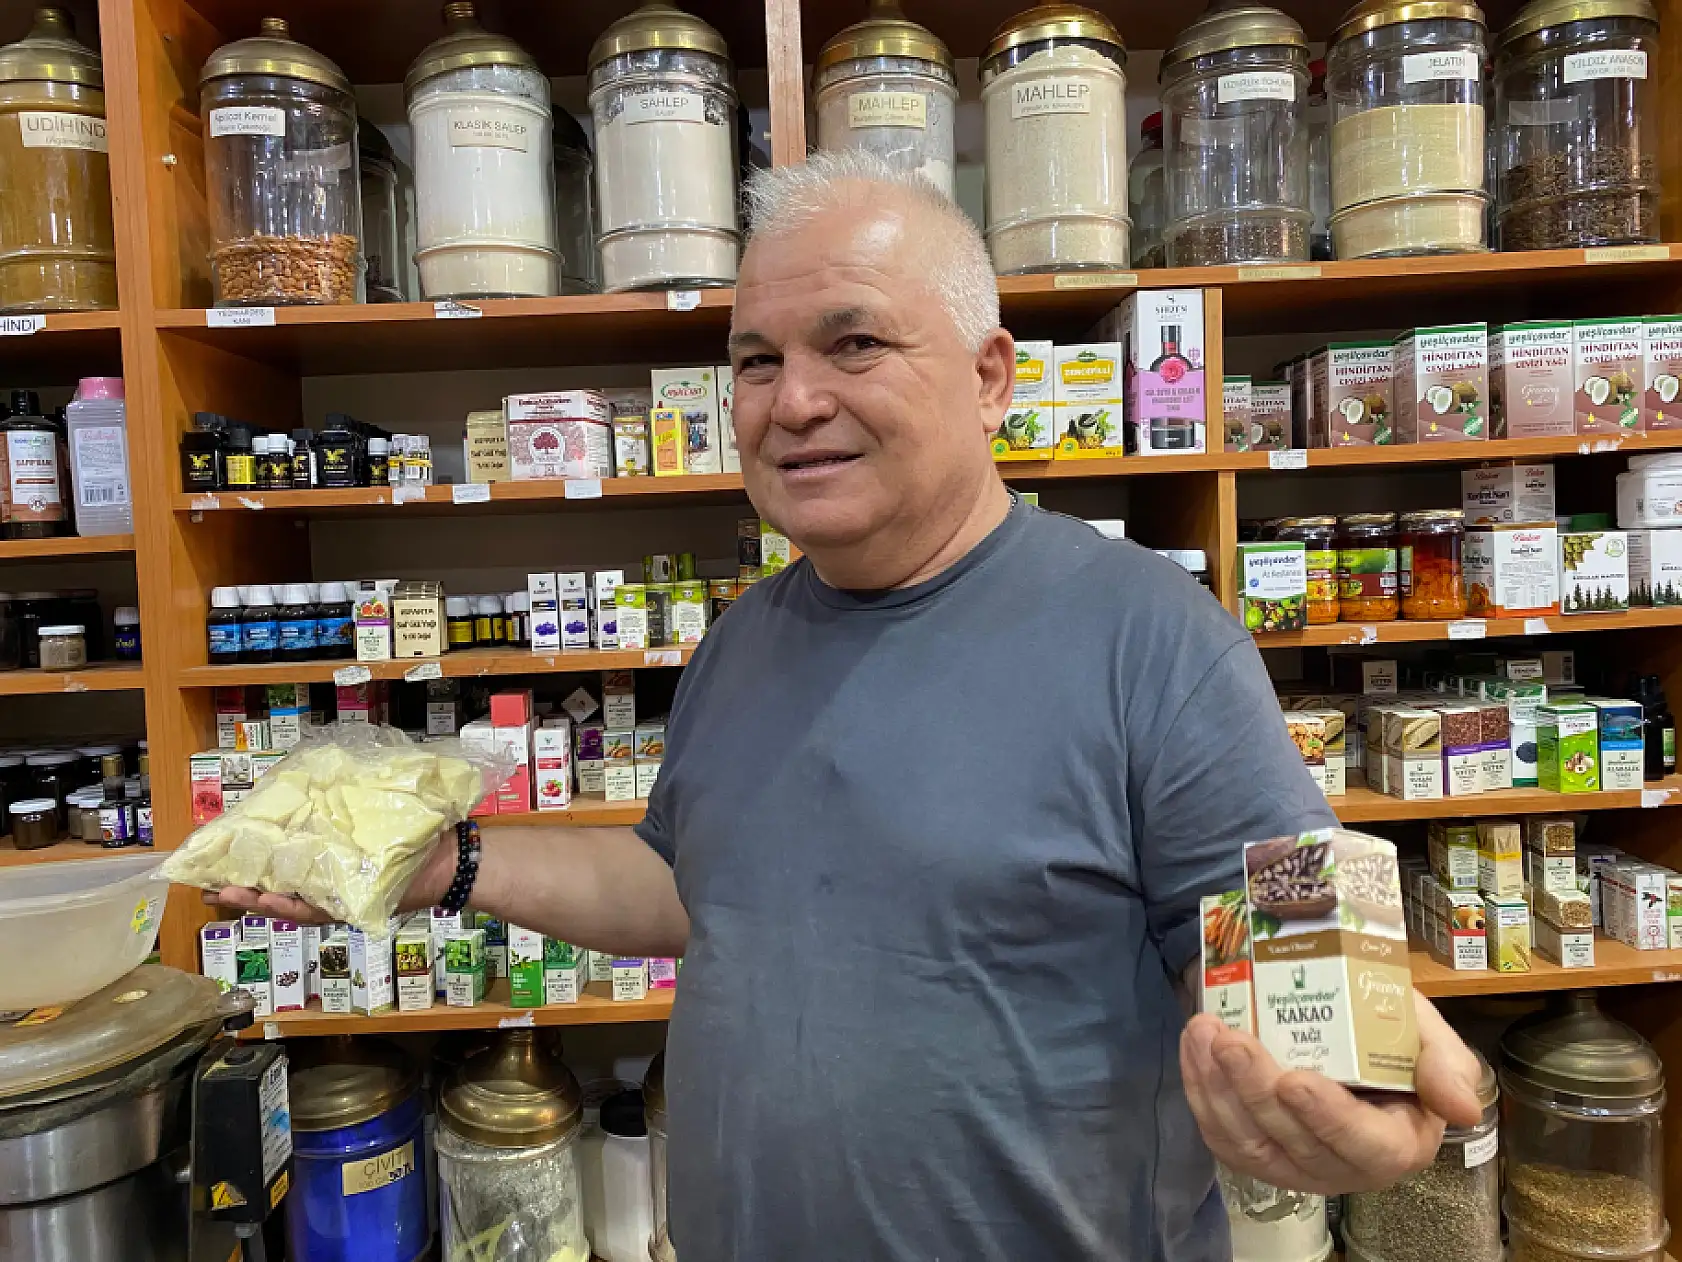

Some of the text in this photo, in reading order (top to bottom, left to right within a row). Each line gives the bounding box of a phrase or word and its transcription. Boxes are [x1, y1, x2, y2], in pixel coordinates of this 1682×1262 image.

[640, 96, 689, 109] SAHLEP
[1017, 84, 1091, 104] MAHLEP
[858, 97, 919, 111] MAHLEP
[1276, 1006, 1333, 1024] KAKAO
[1291, 1026, 1322, 1043] YAĞI
